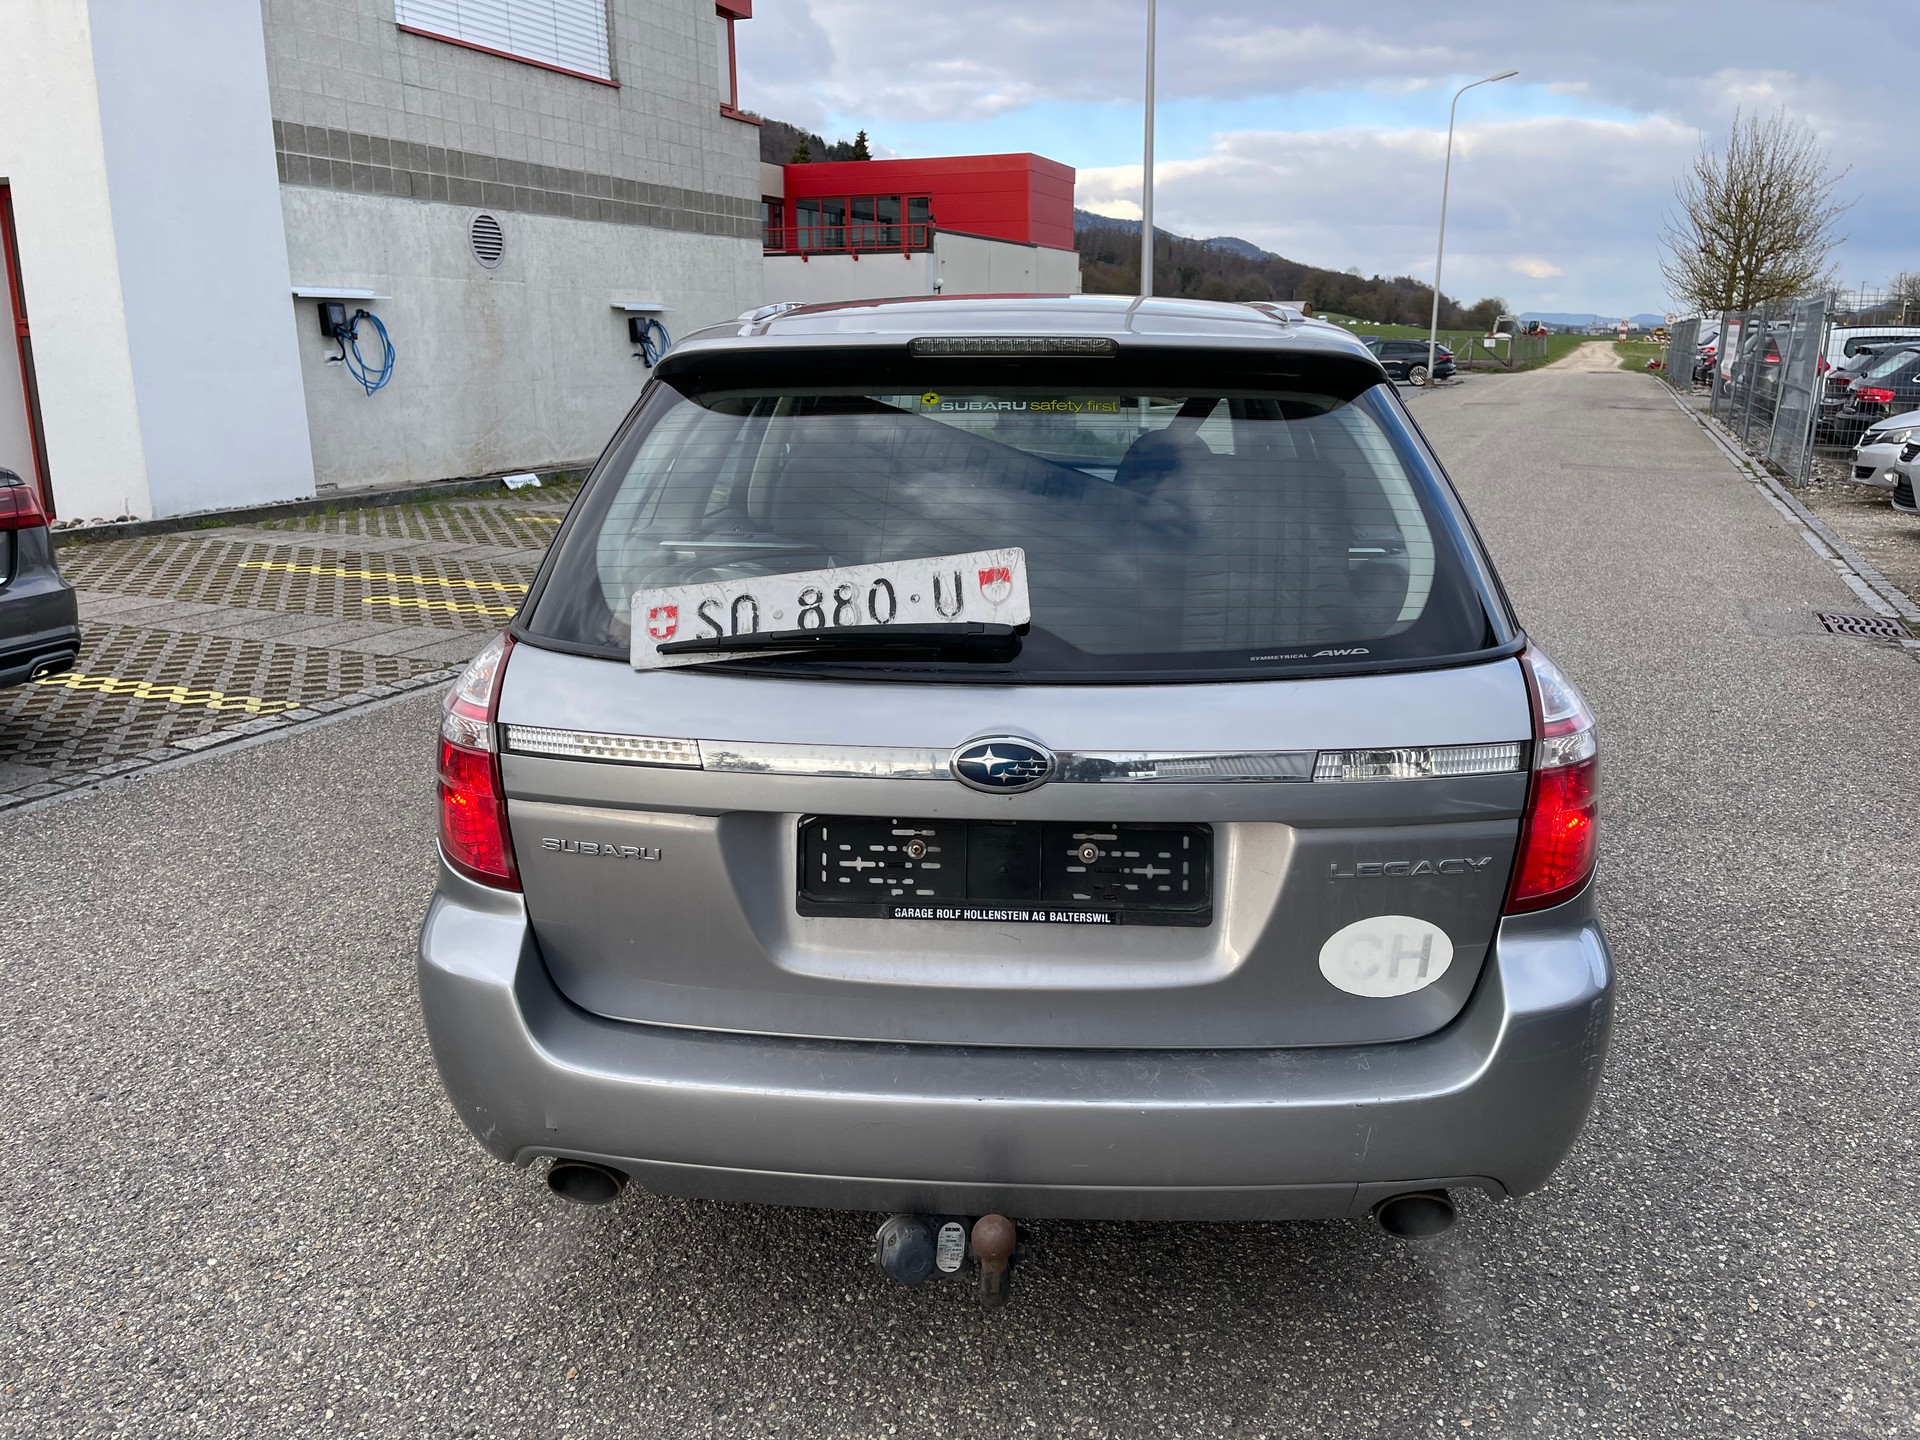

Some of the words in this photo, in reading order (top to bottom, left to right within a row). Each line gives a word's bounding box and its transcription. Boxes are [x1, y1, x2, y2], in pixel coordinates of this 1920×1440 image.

[941, 401, 1026, 411] SUBARU
[1030, 399, 1083, 413] safety
[1087, 400, 1117, 412] first
[1250, 654, 1308, 662] SYMMETRICAL
[1312, 647, 1370, 658] AWD
[541, 837, 662, 861] SUBARU
[1328, 856, 1493, 879] LEGACY
[895, 908, 933, 919] GARAGE
[936, 909, 961, 919] ROLF
[964, 910, 1029, 921] HOLLENSTEIN
[1032, 912, 1045, 922] AG
[1049, 912, 1111, 923] BALTERSWIL
[1342, 933, 1434, 979] CH
